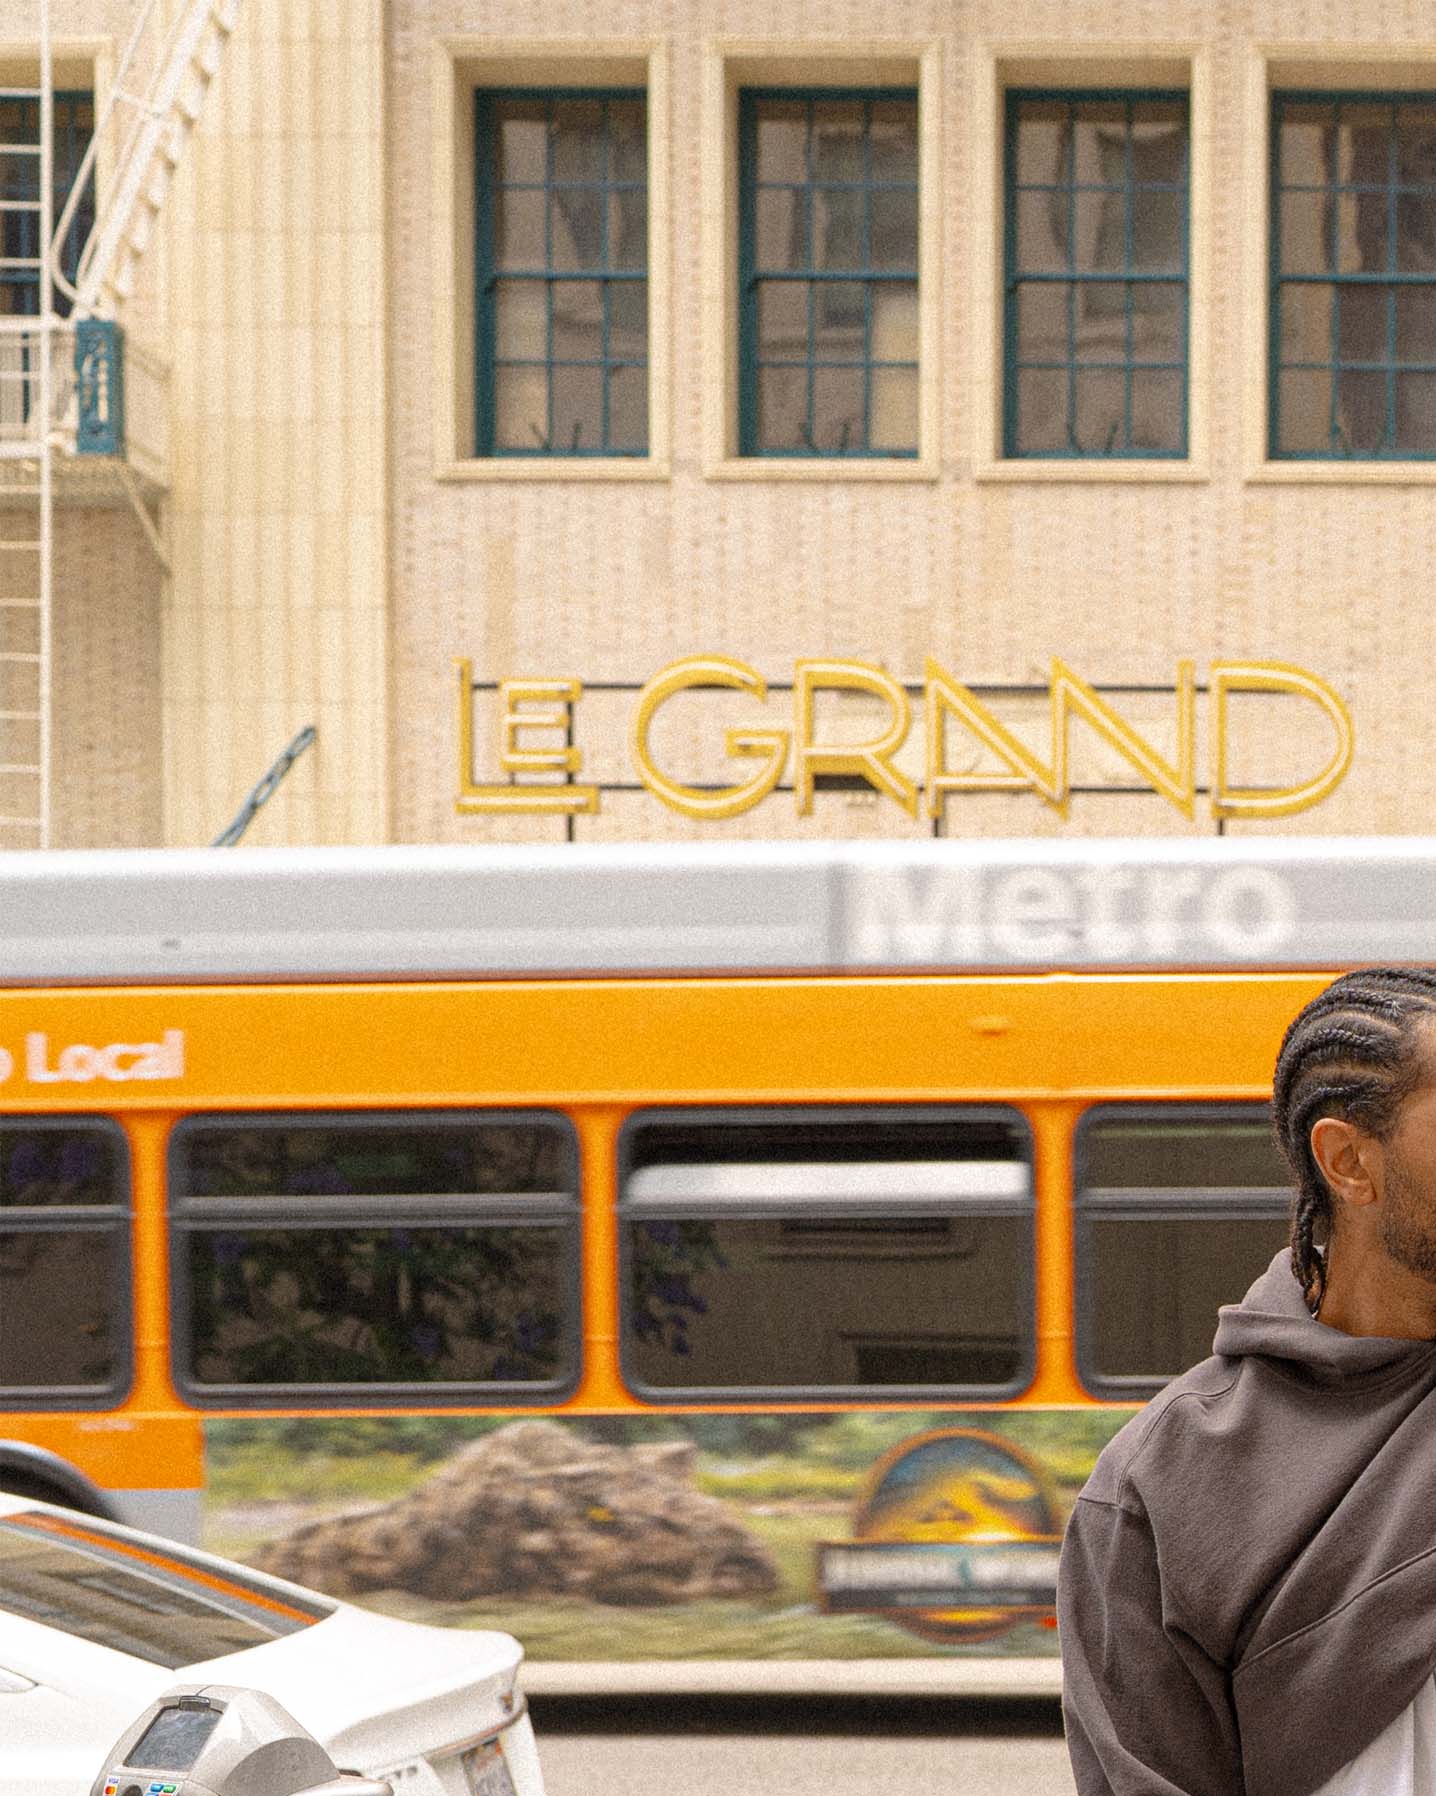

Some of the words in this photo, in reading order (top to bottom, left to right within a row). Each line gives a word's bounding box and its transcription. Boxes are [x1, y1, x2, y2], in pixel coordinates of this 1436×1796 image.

[453, 657, 599, 815] LE
[633, 653, 1356, 820] GRAND
[849, 863, 1296, 960] Metro
[25, 1028, 185, 1083] Local
